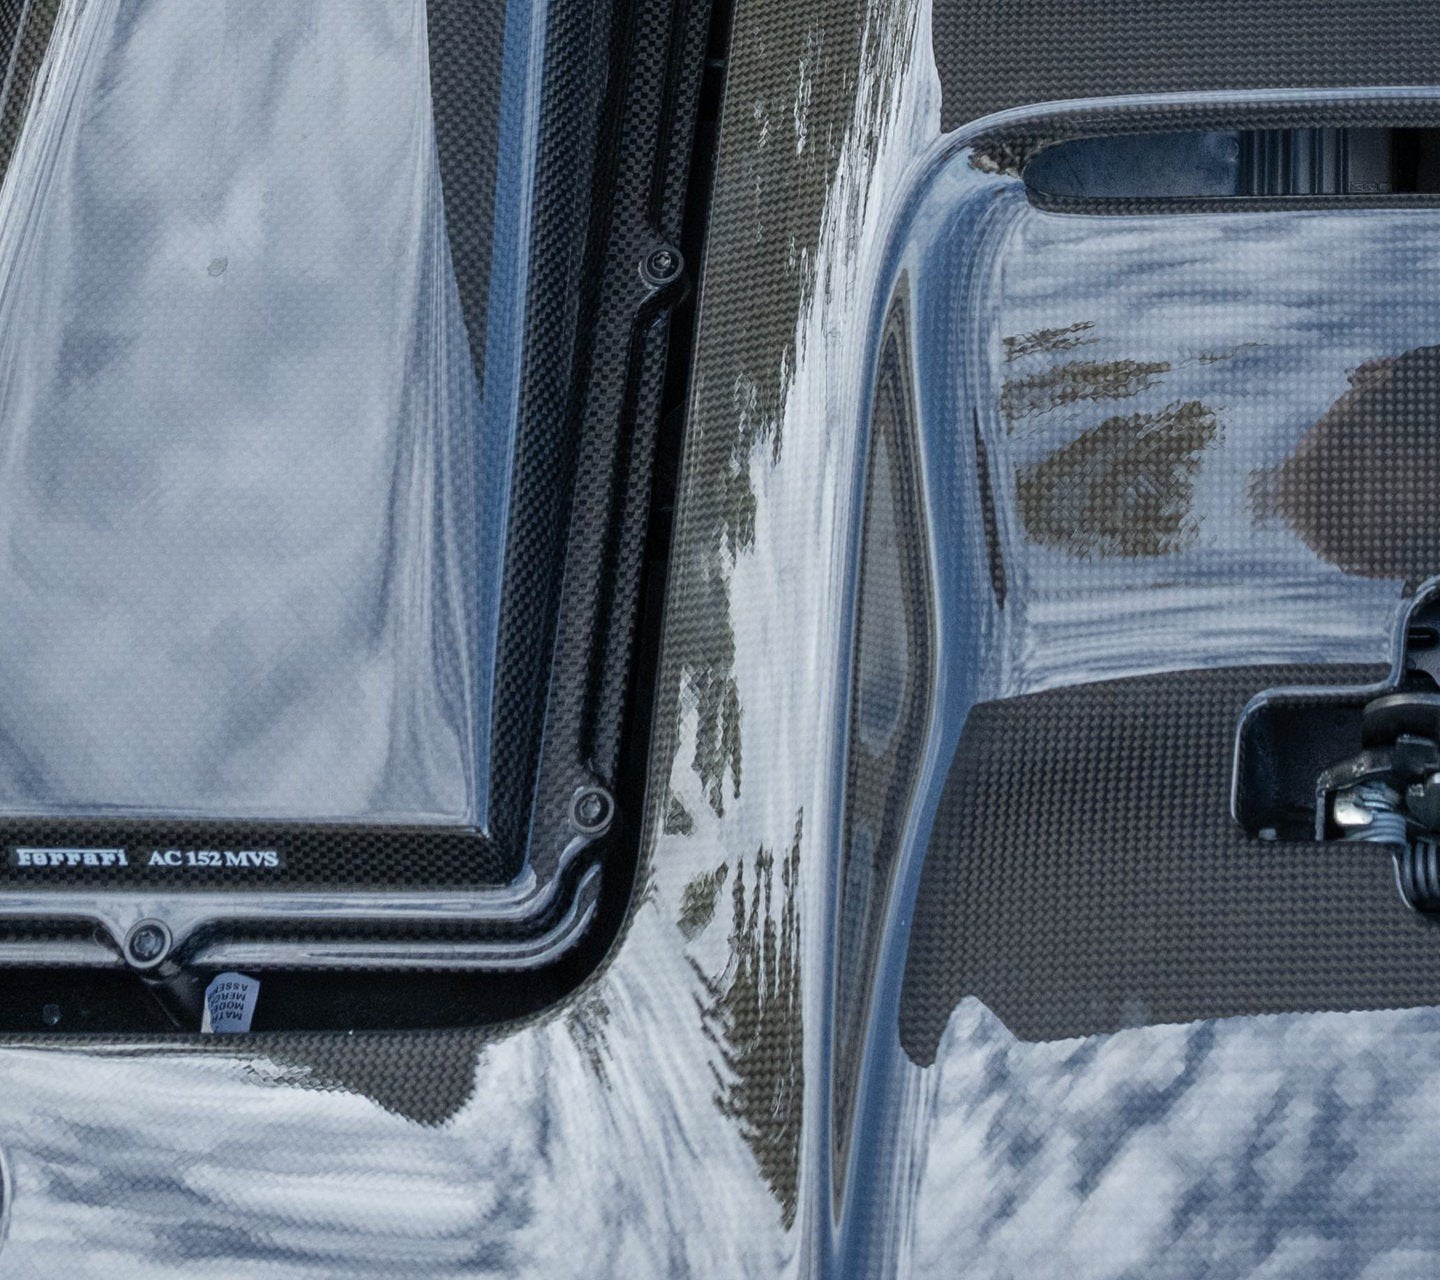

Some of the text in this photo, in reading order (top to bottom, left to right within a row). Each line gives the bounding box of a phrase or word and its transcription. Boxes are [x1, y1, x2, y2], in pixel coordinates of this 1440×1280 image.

[16, 848, 279, 867] Ferrari AC 152 MVS
